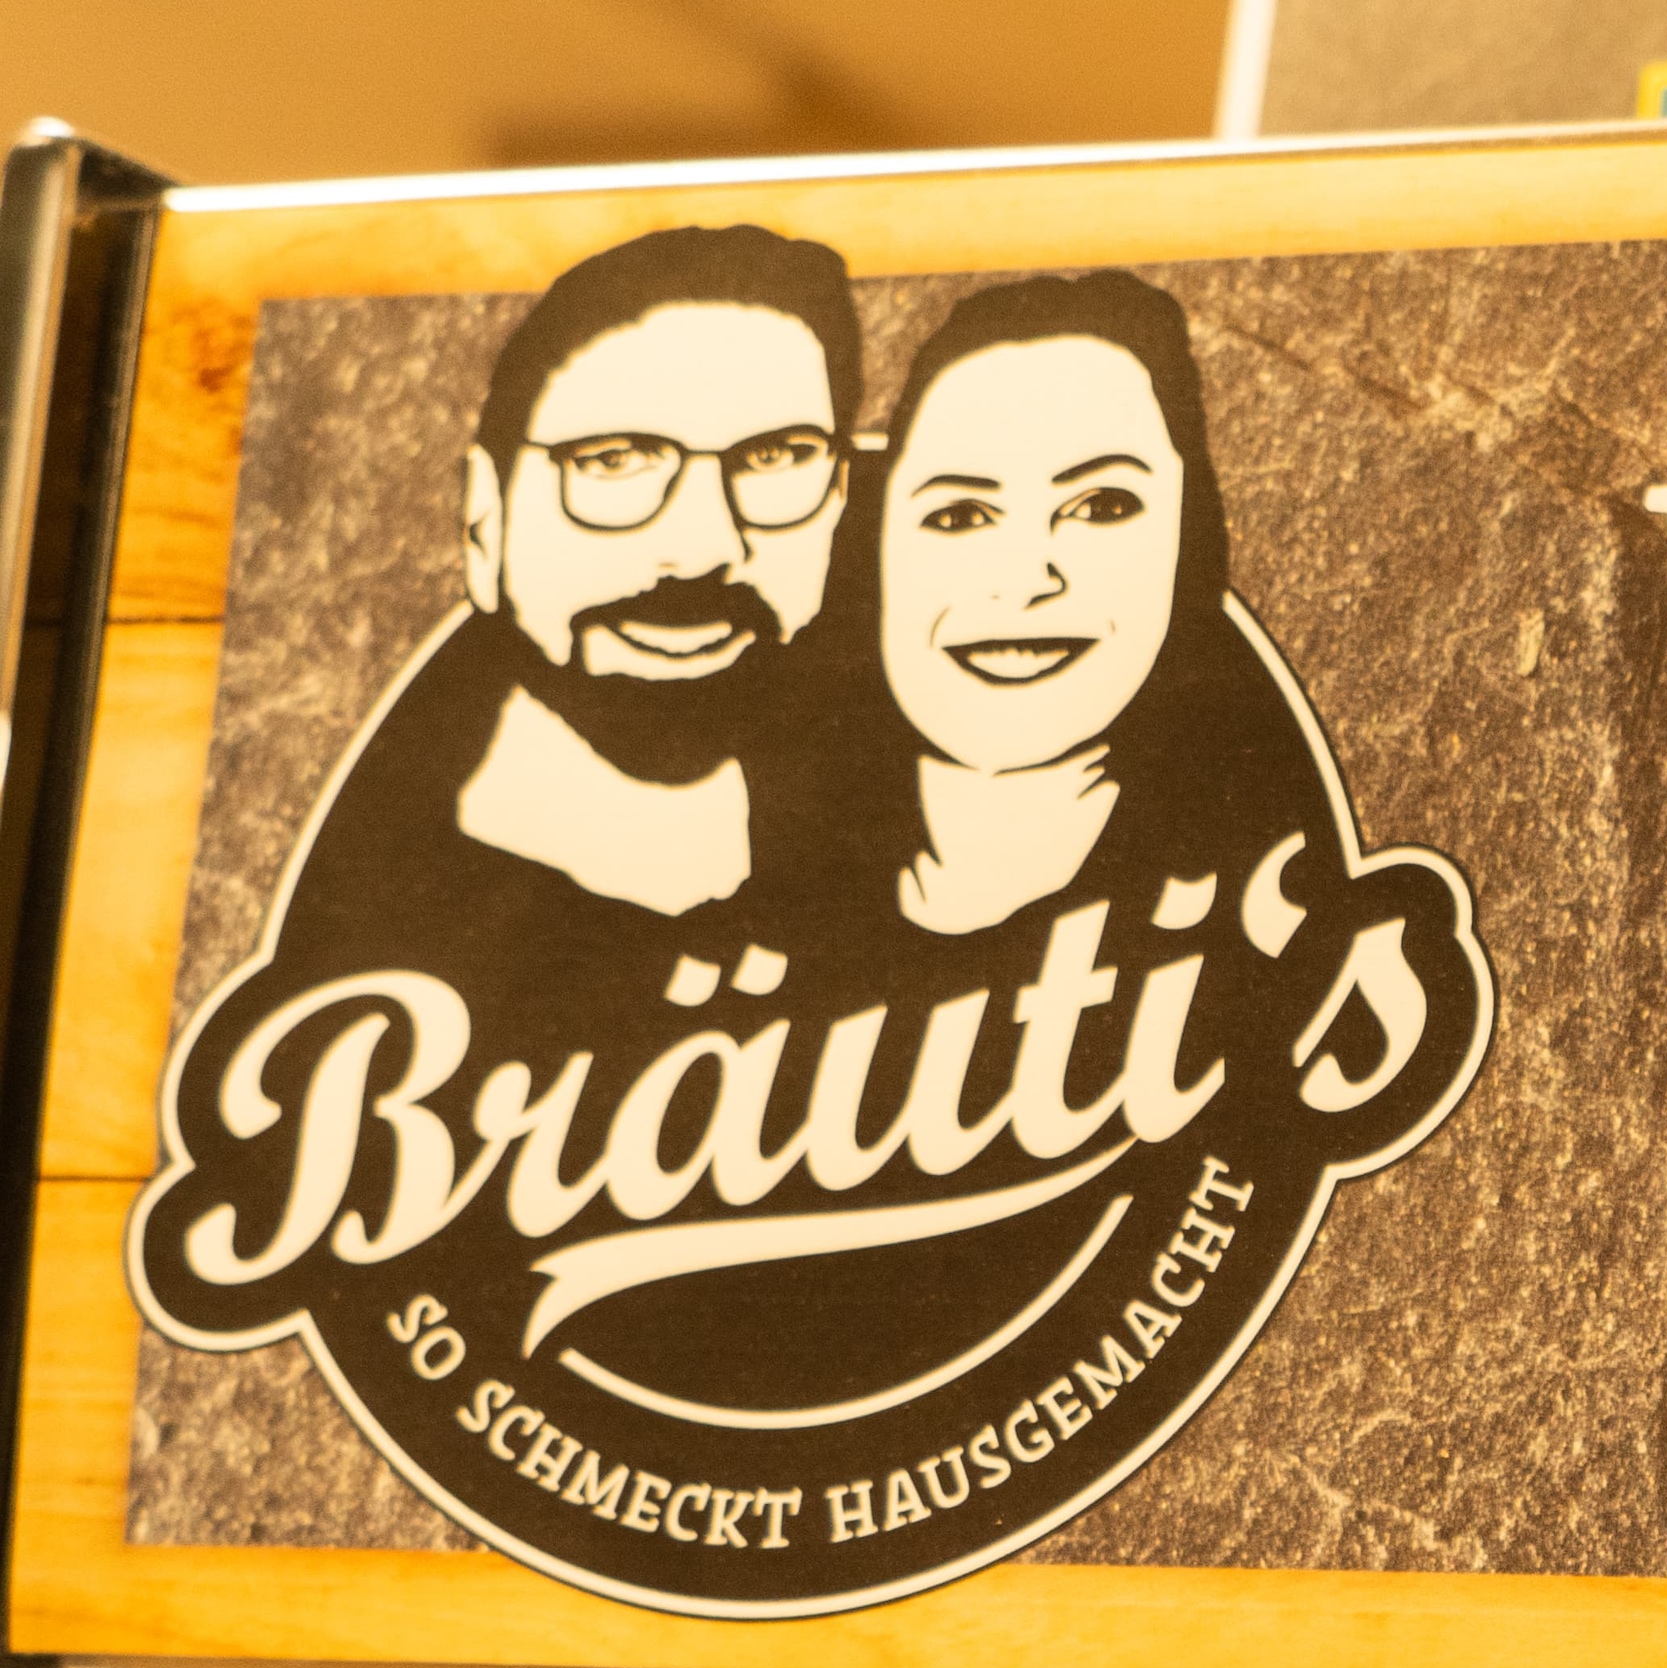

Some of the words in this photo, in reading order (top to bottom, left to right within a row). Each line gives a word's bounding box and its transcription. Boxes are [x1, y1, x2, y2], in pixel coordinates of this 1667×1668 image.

[184, 830, 1430, 1287] Bräuti's
[385, 1294, 467, 1381] SO
[456, 1379, 802, 1549] SCHMECKT
[826, 1154, 1256, 1544] HAUSGEMACHT
